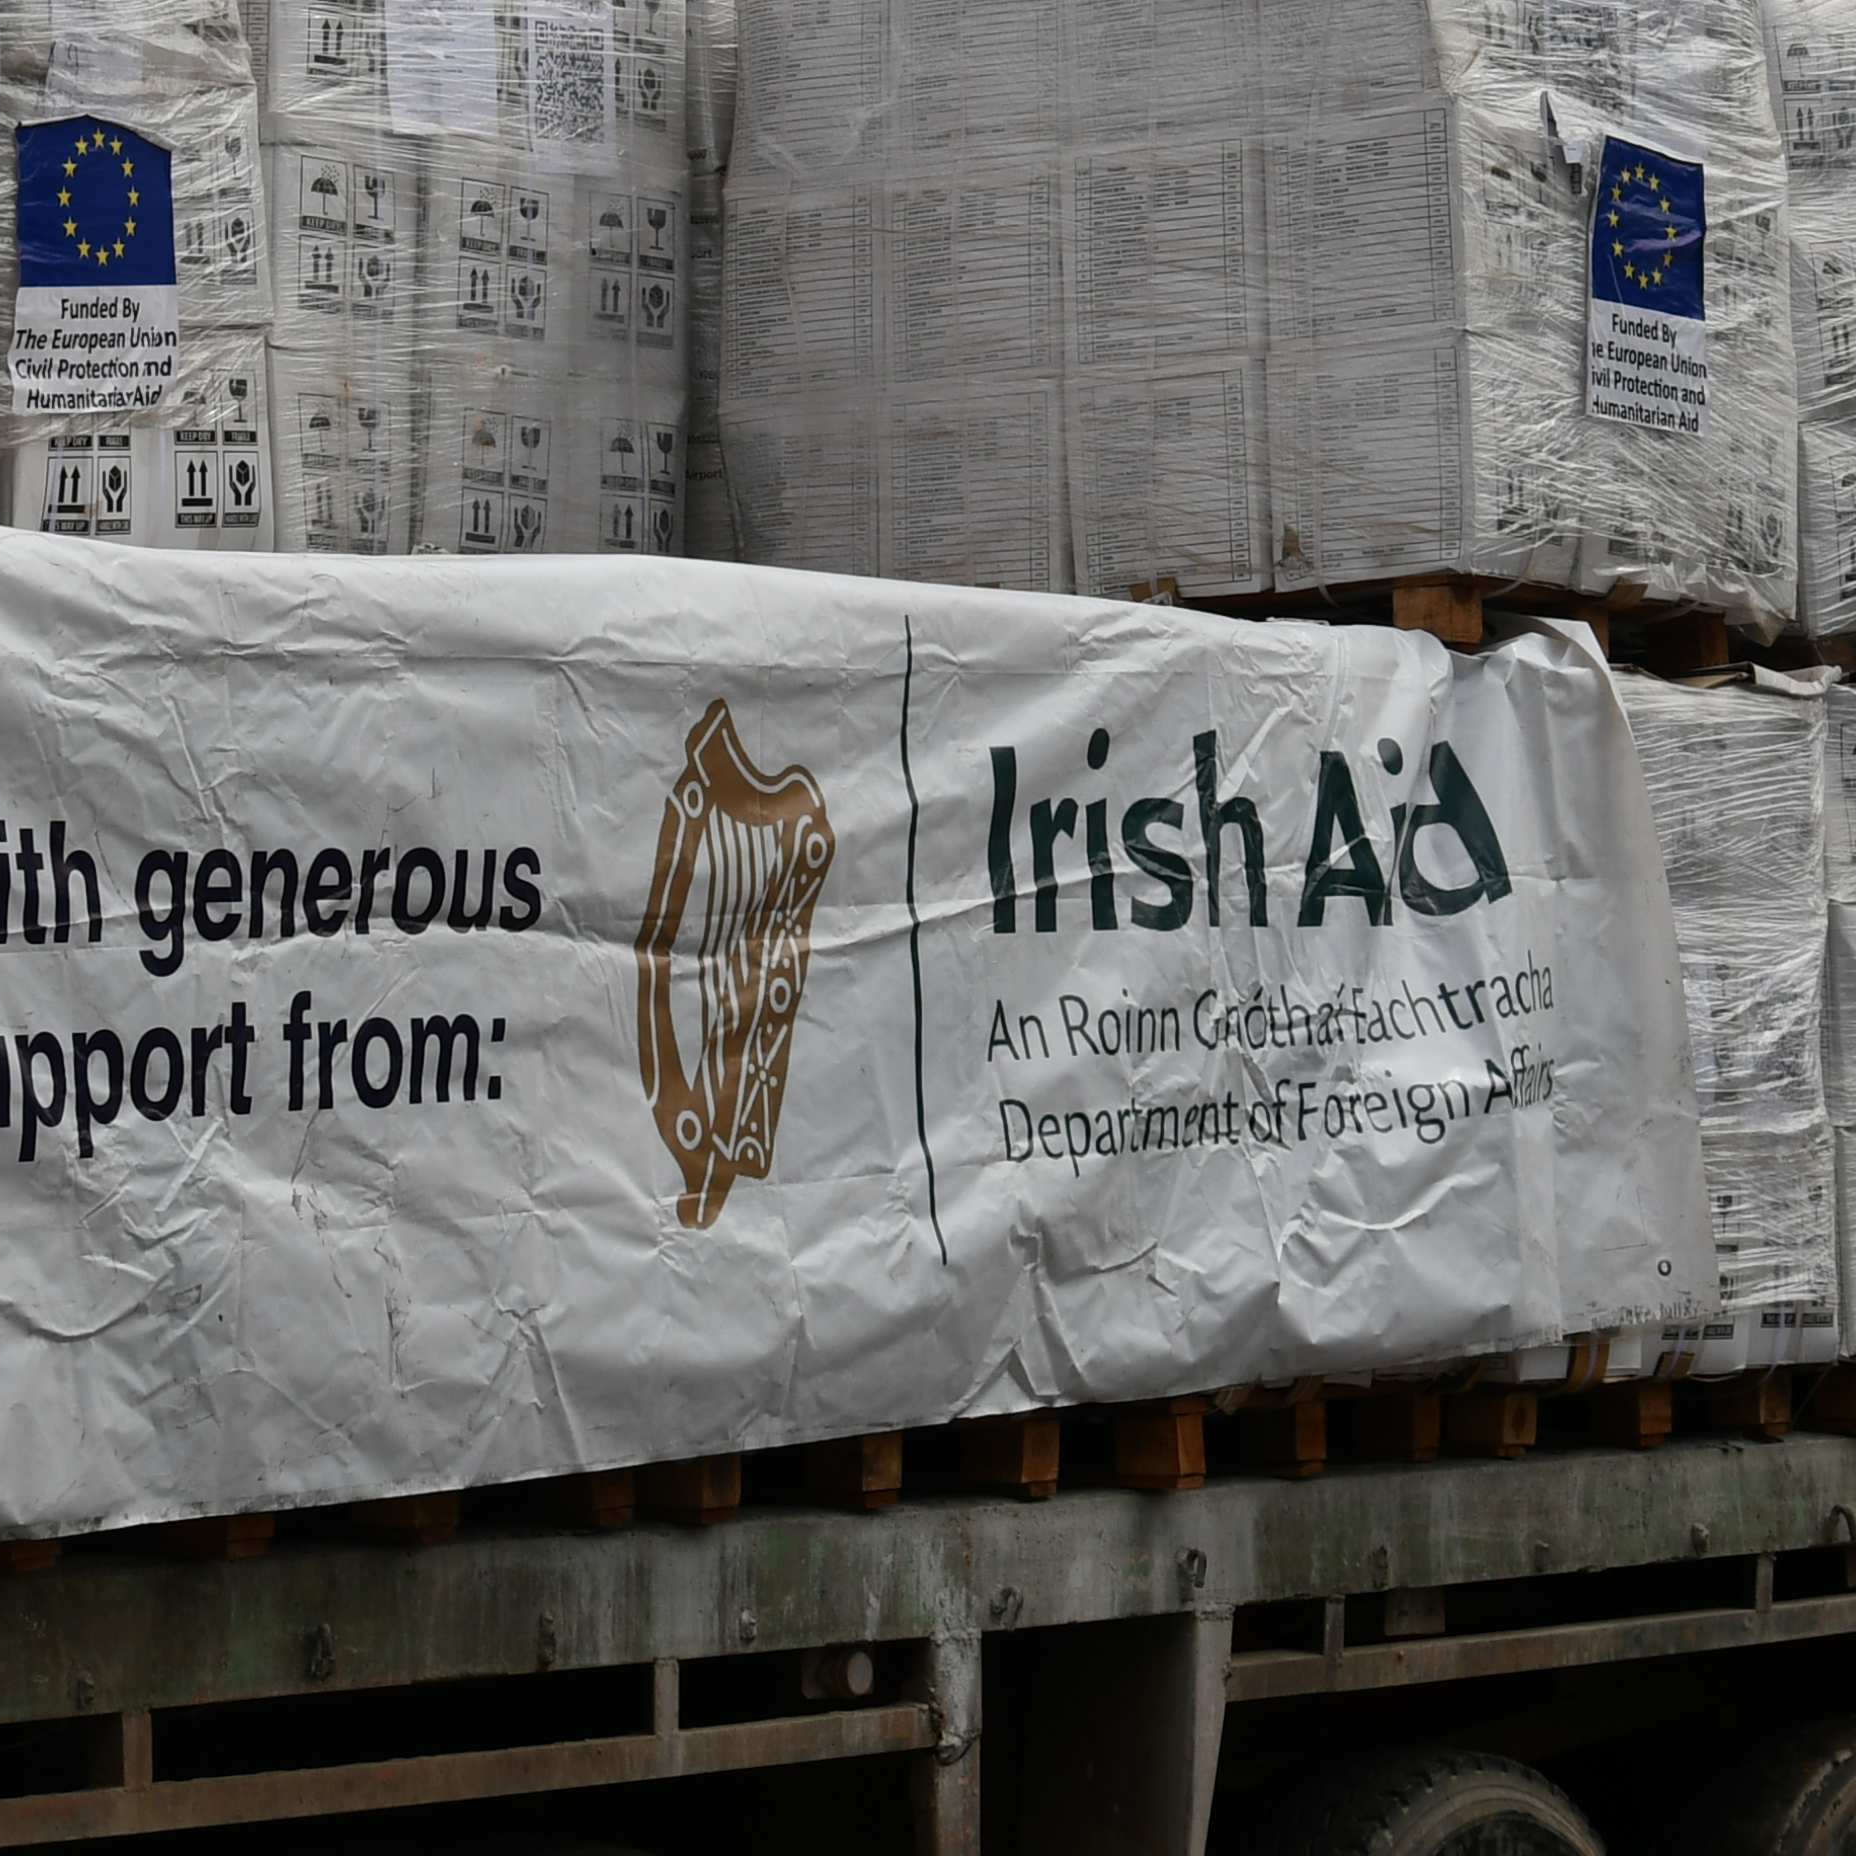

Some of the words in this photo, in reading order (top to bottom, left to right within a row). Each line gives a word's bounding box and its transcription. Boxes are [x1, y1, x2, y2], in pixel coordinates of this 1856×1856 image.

[307, 217, 324, 228] KEEP
[61, 296, 118, 319] Funded
[123, 298, 140, 323] By
[16, 328, 47, 349] The
[52, 329, 125, 354] European
[130, 326, 177, 348] Union
[1612, 313, 1658, 340] Funded
[1662, 323, 1677, 349] By
[15, 357, 53, 379] Civil
[58, 356, 138, 379] Protection
[1608, 341, 1667, 371] European
[1671, 353, 1707, 378] Union
[133, 384, 162, 406] Aid
[1591, 365, 1610, 388] ivil
[1614, 371, 1678, 401] Protection
[1681, 385, 1705, 405] and
[1679, 411, 1699, 432] Aid
[180, 432, 197, 440] KEEP
[198, 432, 212, 441] DRY
[61, 521, 75, 531] WAY
[180, 515, 193, 523] THIS
[988, 727, 1269, 934] Irish
[1297, 737, 1513, 927] Aid
[134, 845, 542, 977] generous
[987, 999, 1049, 1063] An
[1059, 988, 1181, 1057] Roinn
[1349, 950, 1555, 1045] Eachtracha
[283, 990, 506, 1113] from:
[998, 1090, 1240, 1178] Department
[1249, 1079, 1291, 1146] of
[1297, 1070, 1470, 1144] Foreign
[1484, 1043, 1555, 1115] Affairs
